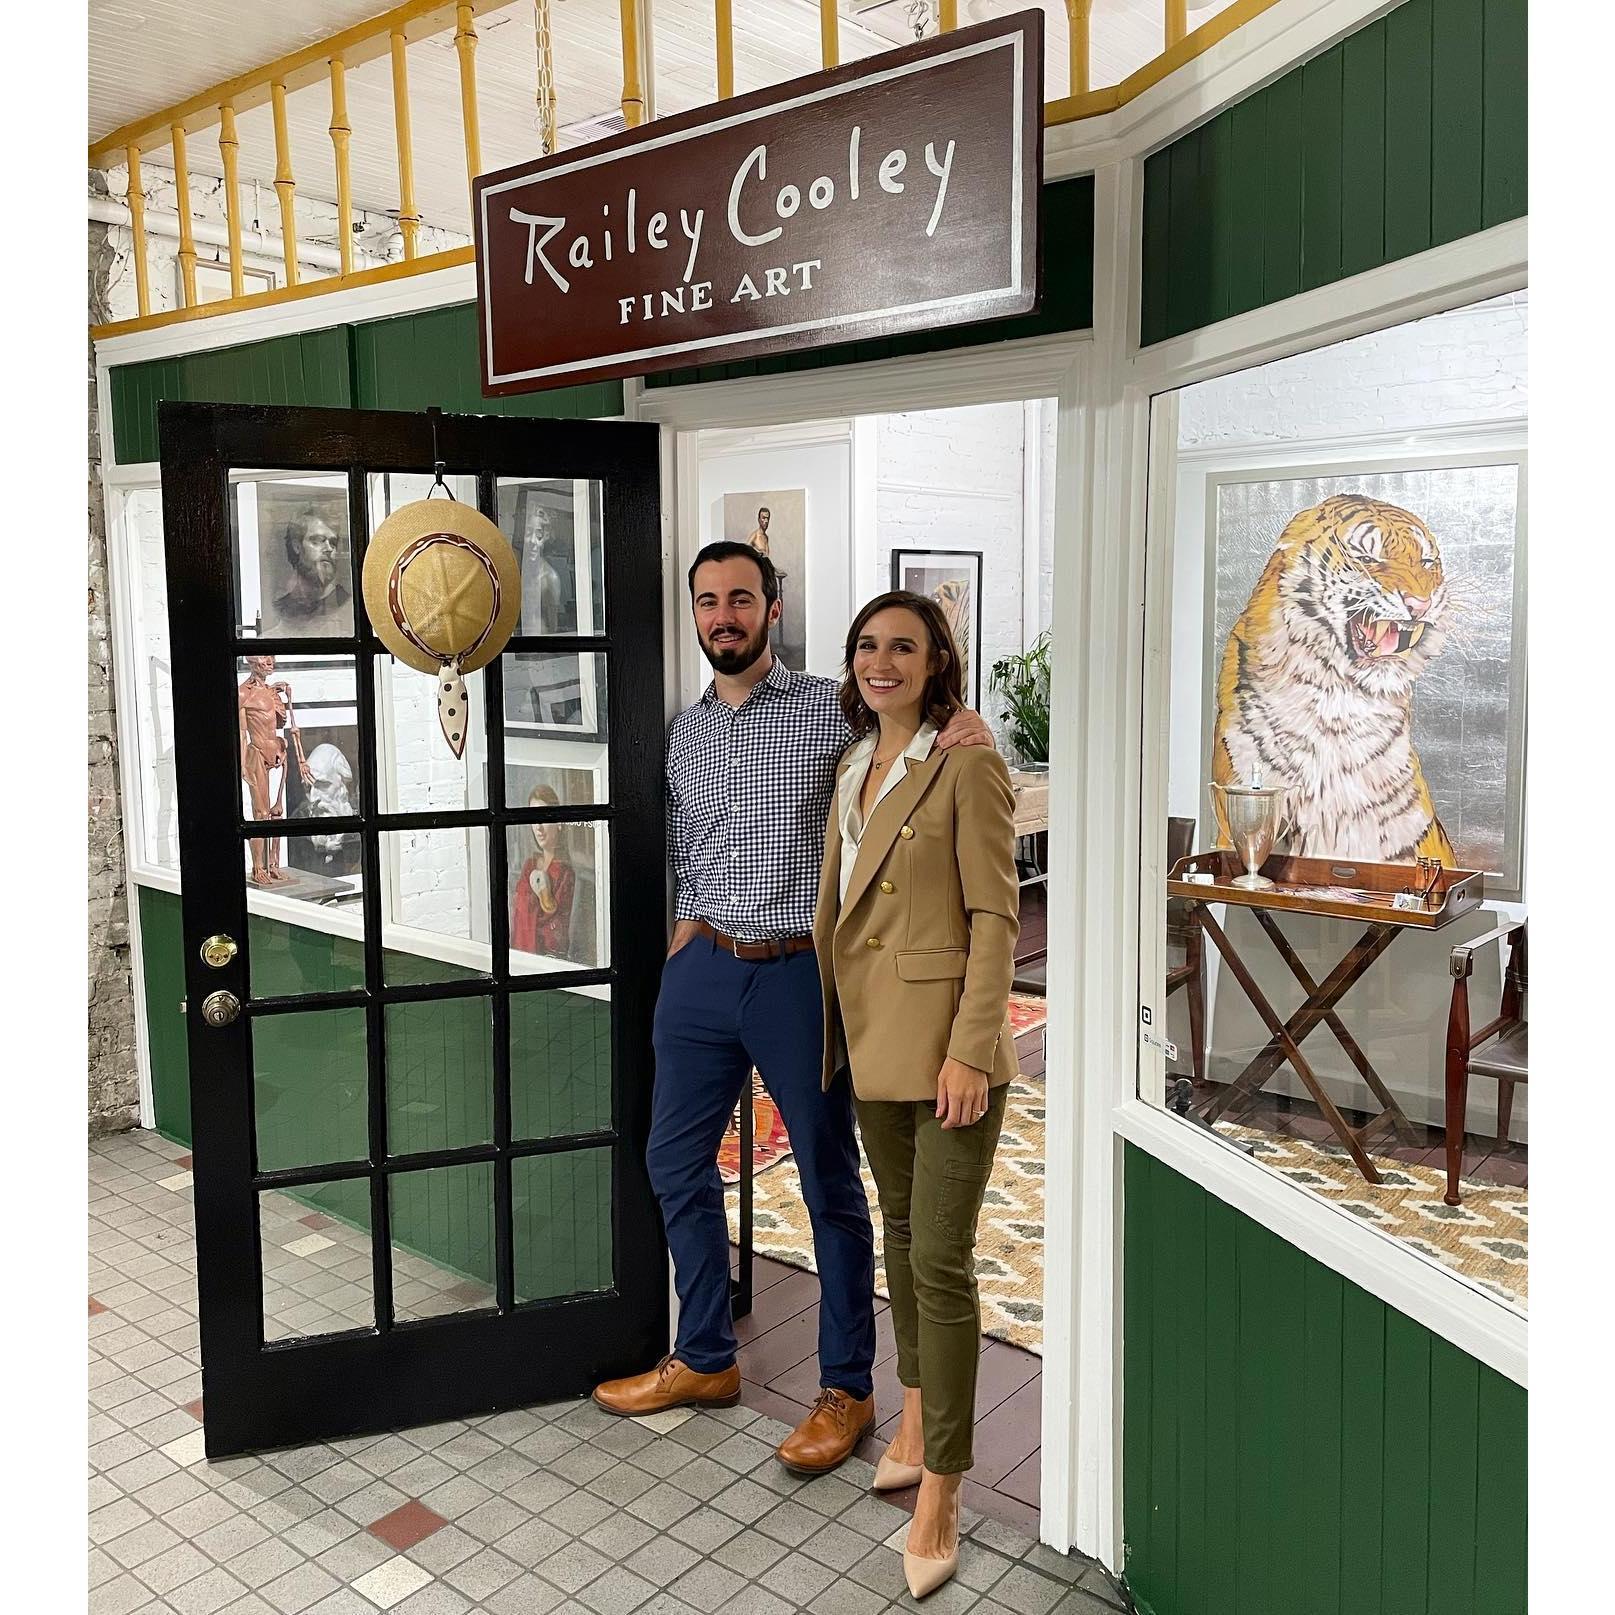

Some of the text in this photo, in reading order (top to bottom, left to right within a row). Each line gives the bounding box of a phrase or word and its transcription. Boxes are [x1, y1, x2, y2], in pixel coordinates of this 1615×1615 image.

[509, 126, 955, 293] Railey Cooley
[618, 259, 822, 325] FINE ART
